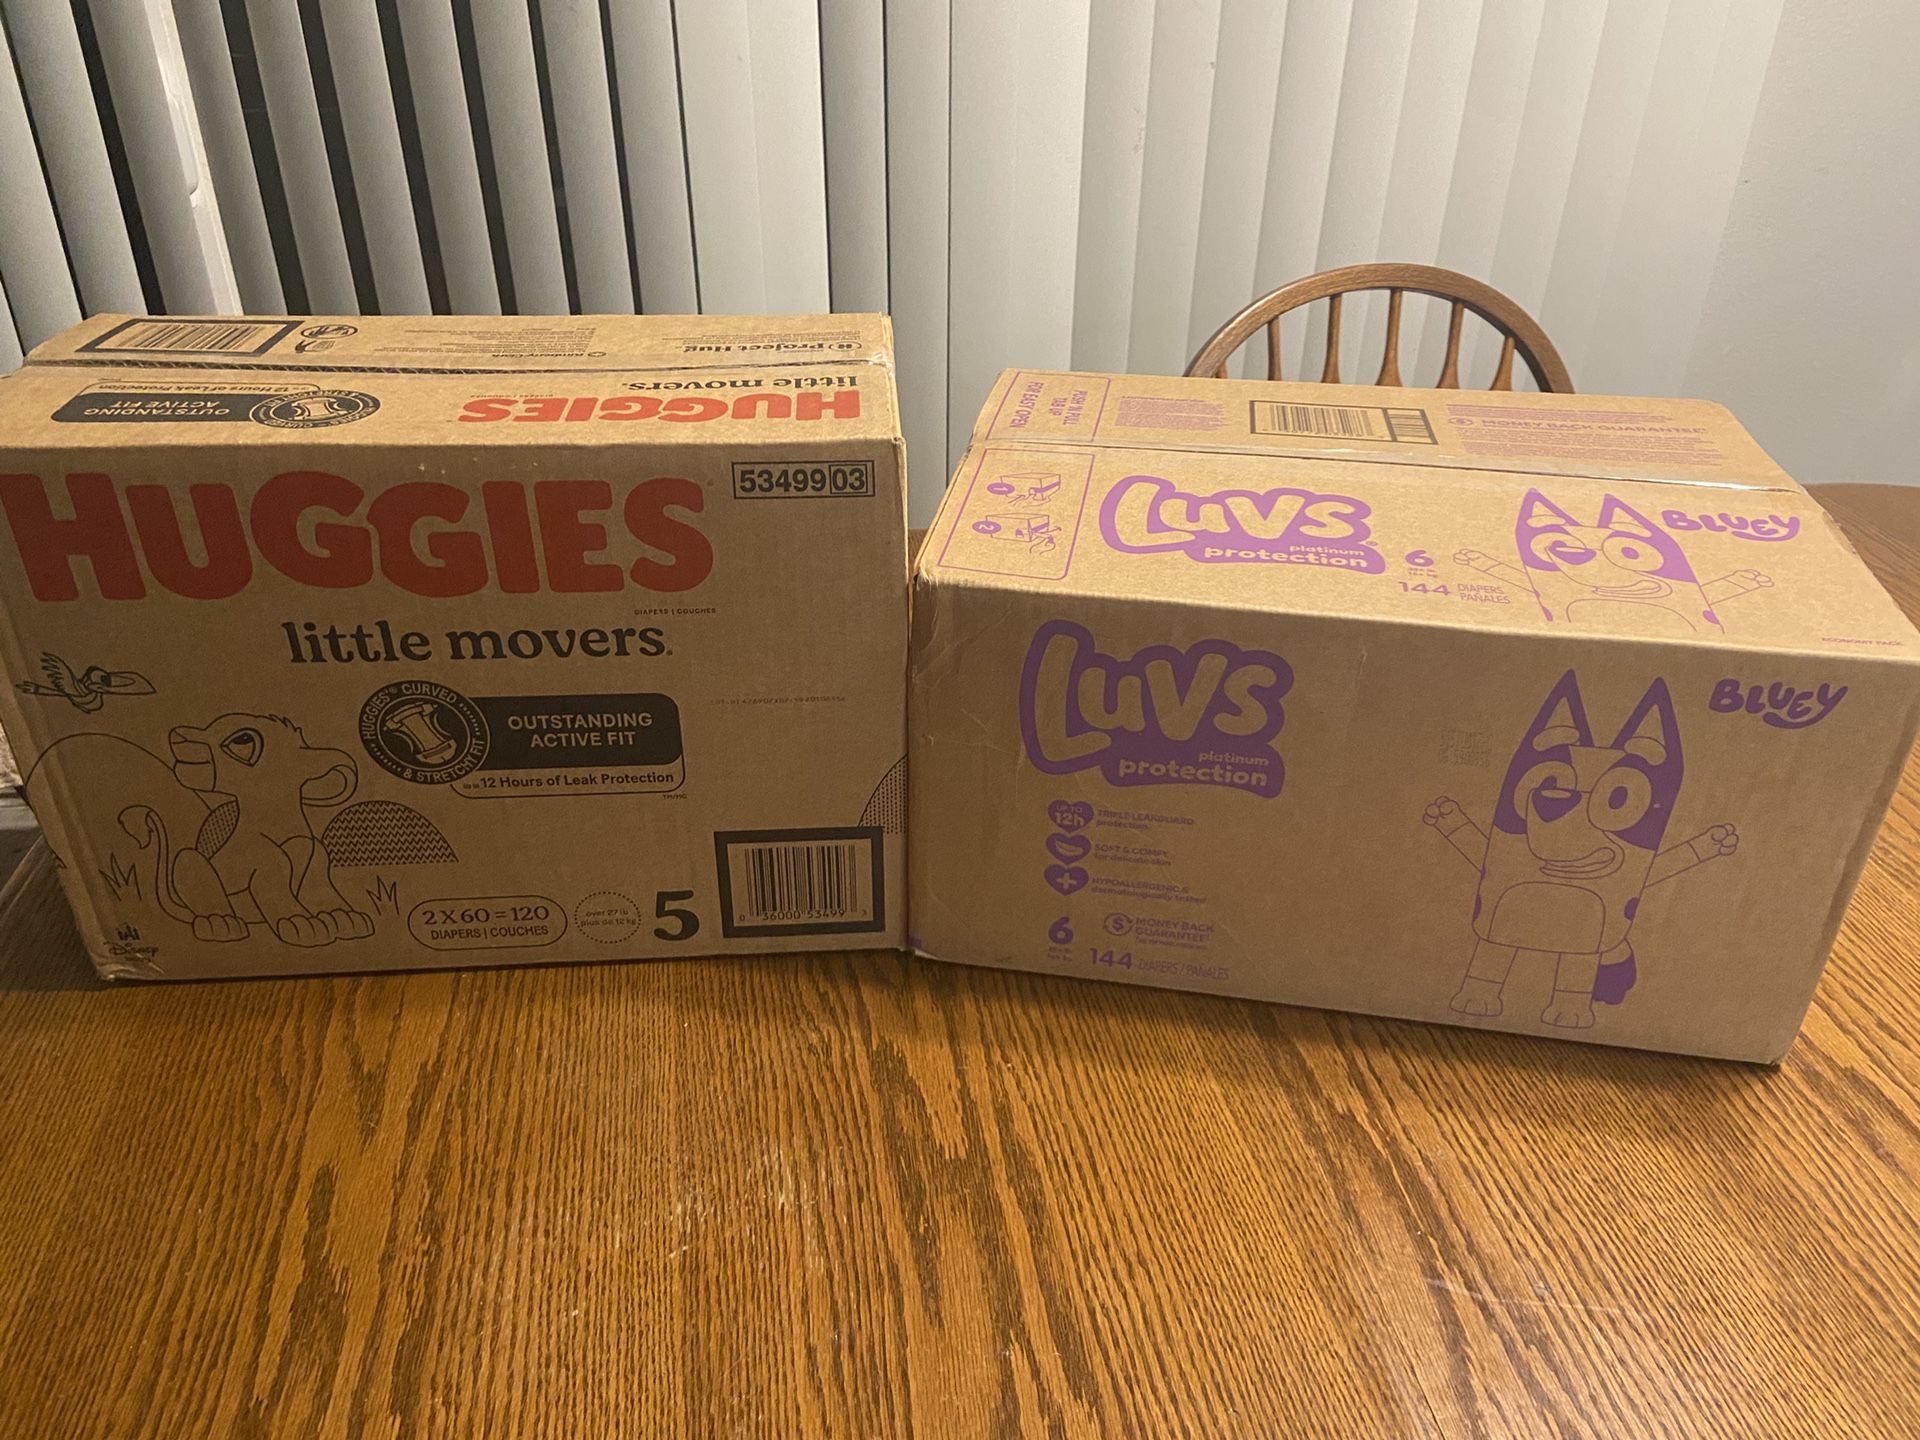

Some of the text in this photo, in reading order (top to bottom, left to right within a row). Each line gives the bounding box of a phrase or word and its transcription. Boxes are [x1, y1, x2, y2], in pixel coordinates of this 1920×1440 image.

[773, 375, 859, 388] little
[83, 407, 230, 416] OUTSTANDING
[111, 400, 221, 409] ACTIVE FIT
[457, 390, 860, 423] HUGGIES
[739, 467, 866, 493] 53499 03
[0, 470, 715, 602] HUGGIES
[1203, 546, 1368, 569] protection
[1289, 544, 1366, 558] platinum
[1404, 549, 1434, 568] 6
[1399, 581, 1451, 596] 144
[1457, 582, 1504, 596] DIAPERS
[281, 620, 674, 663] little movers.
[400, 683, 457, 704] CURVED
[507, 712, 653, 731] OUTSTANDING
[530, 731, 637, 749] ACTIVE FIT
[416, 755, 479, 783] STRETCHY
[471, 737, 486, 756] FIT
[1198, 751, 1270, 767] platinum
[480, 775, 497, 789] 12
[499, 775, 543, 788] Hours
[546, 774, 562, 787] of
[564, 773, 599, 786] Leak
[602, 771, 674, 785] Protection
[1118, 758, 1269, 787] protection
[1055, 812, 1085, 827] 12h
[653, 890, 701, 941] 5
[431, 927, 482, 941] DIAPERS
[490, 924, 550, 938] COUCHES
[1048, 916, 1074, 945] 6
[1089, 947, 1134, 970] 144
